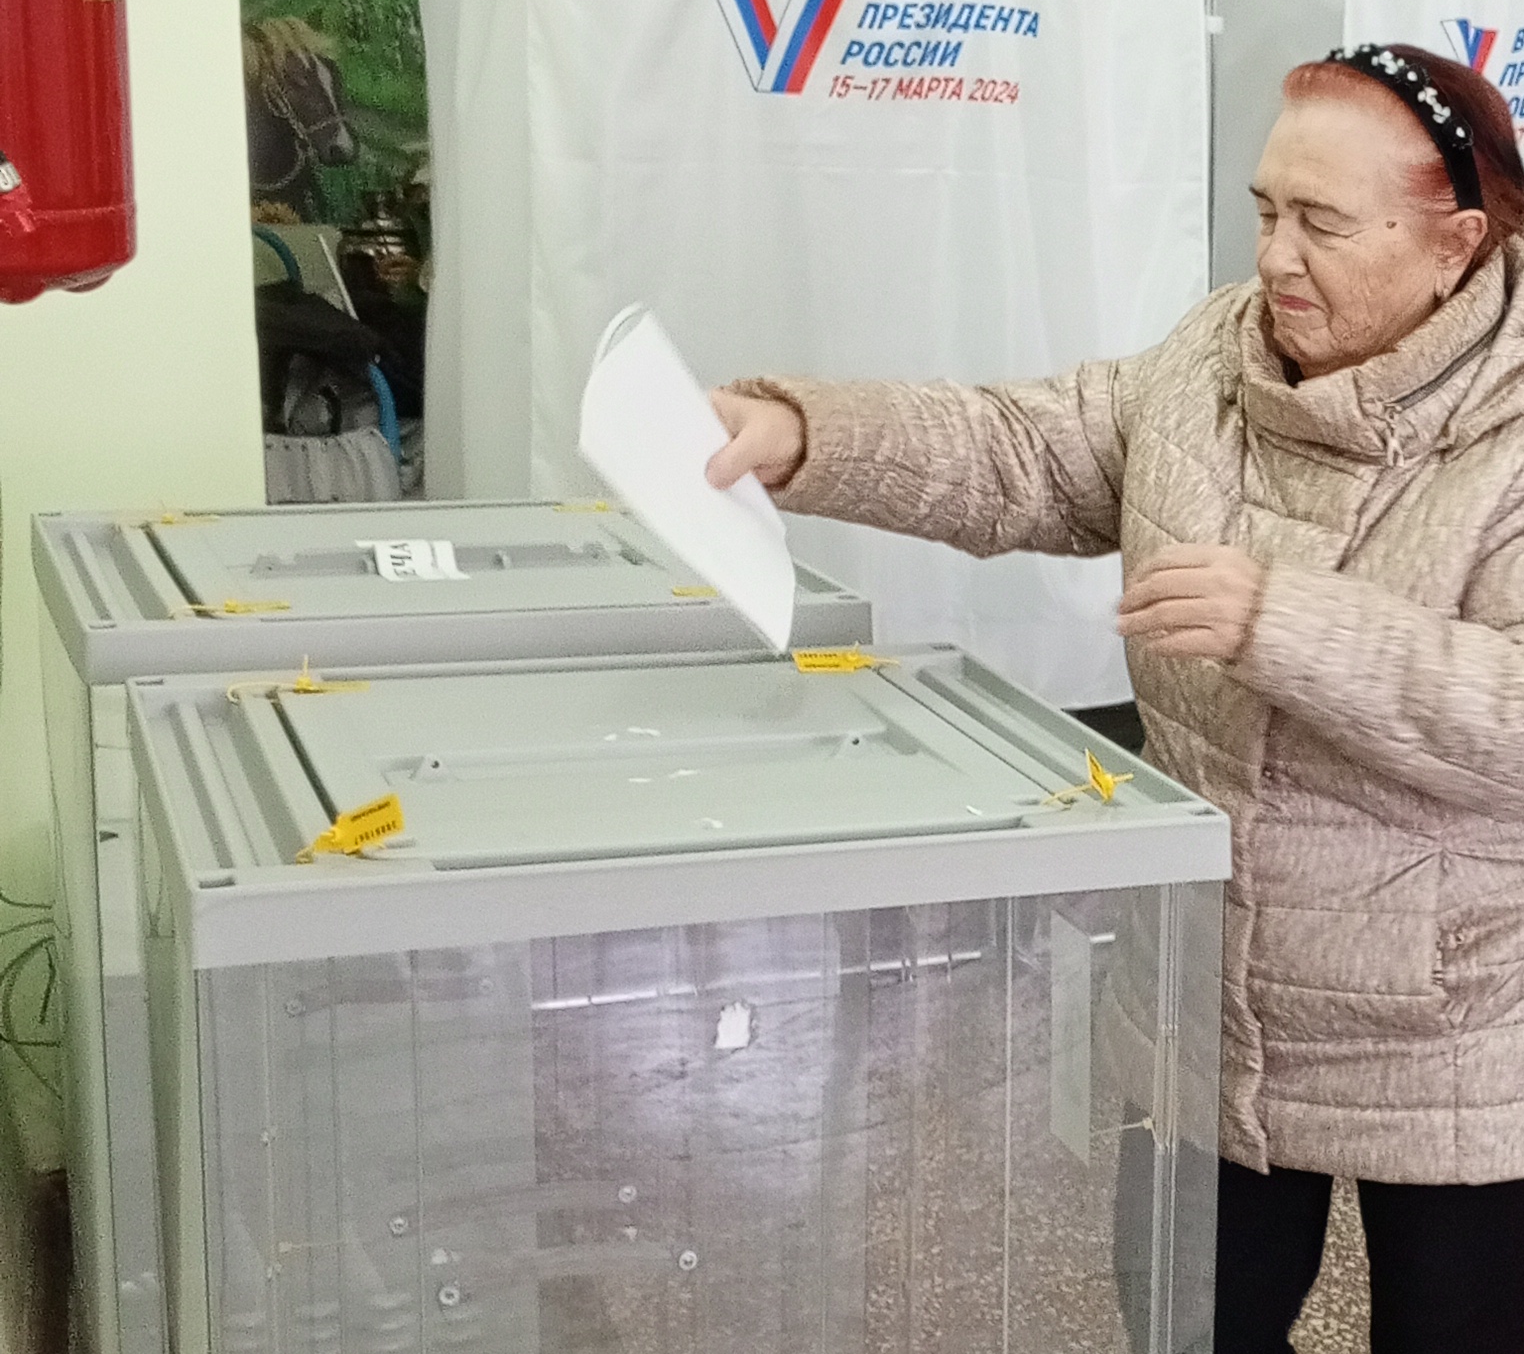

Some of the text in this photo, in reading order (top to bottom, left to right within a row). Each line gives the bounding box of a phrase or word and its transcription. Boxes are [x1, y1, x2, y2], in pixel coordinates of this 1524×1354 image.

[857, 2, 1041, 38] ПРЕЗИДЕНТА
[840, 40, 963, 68] РОССИИ
[892, 76, 965, 102] МАРТА
[968, 78, 1020, 105] 2024
